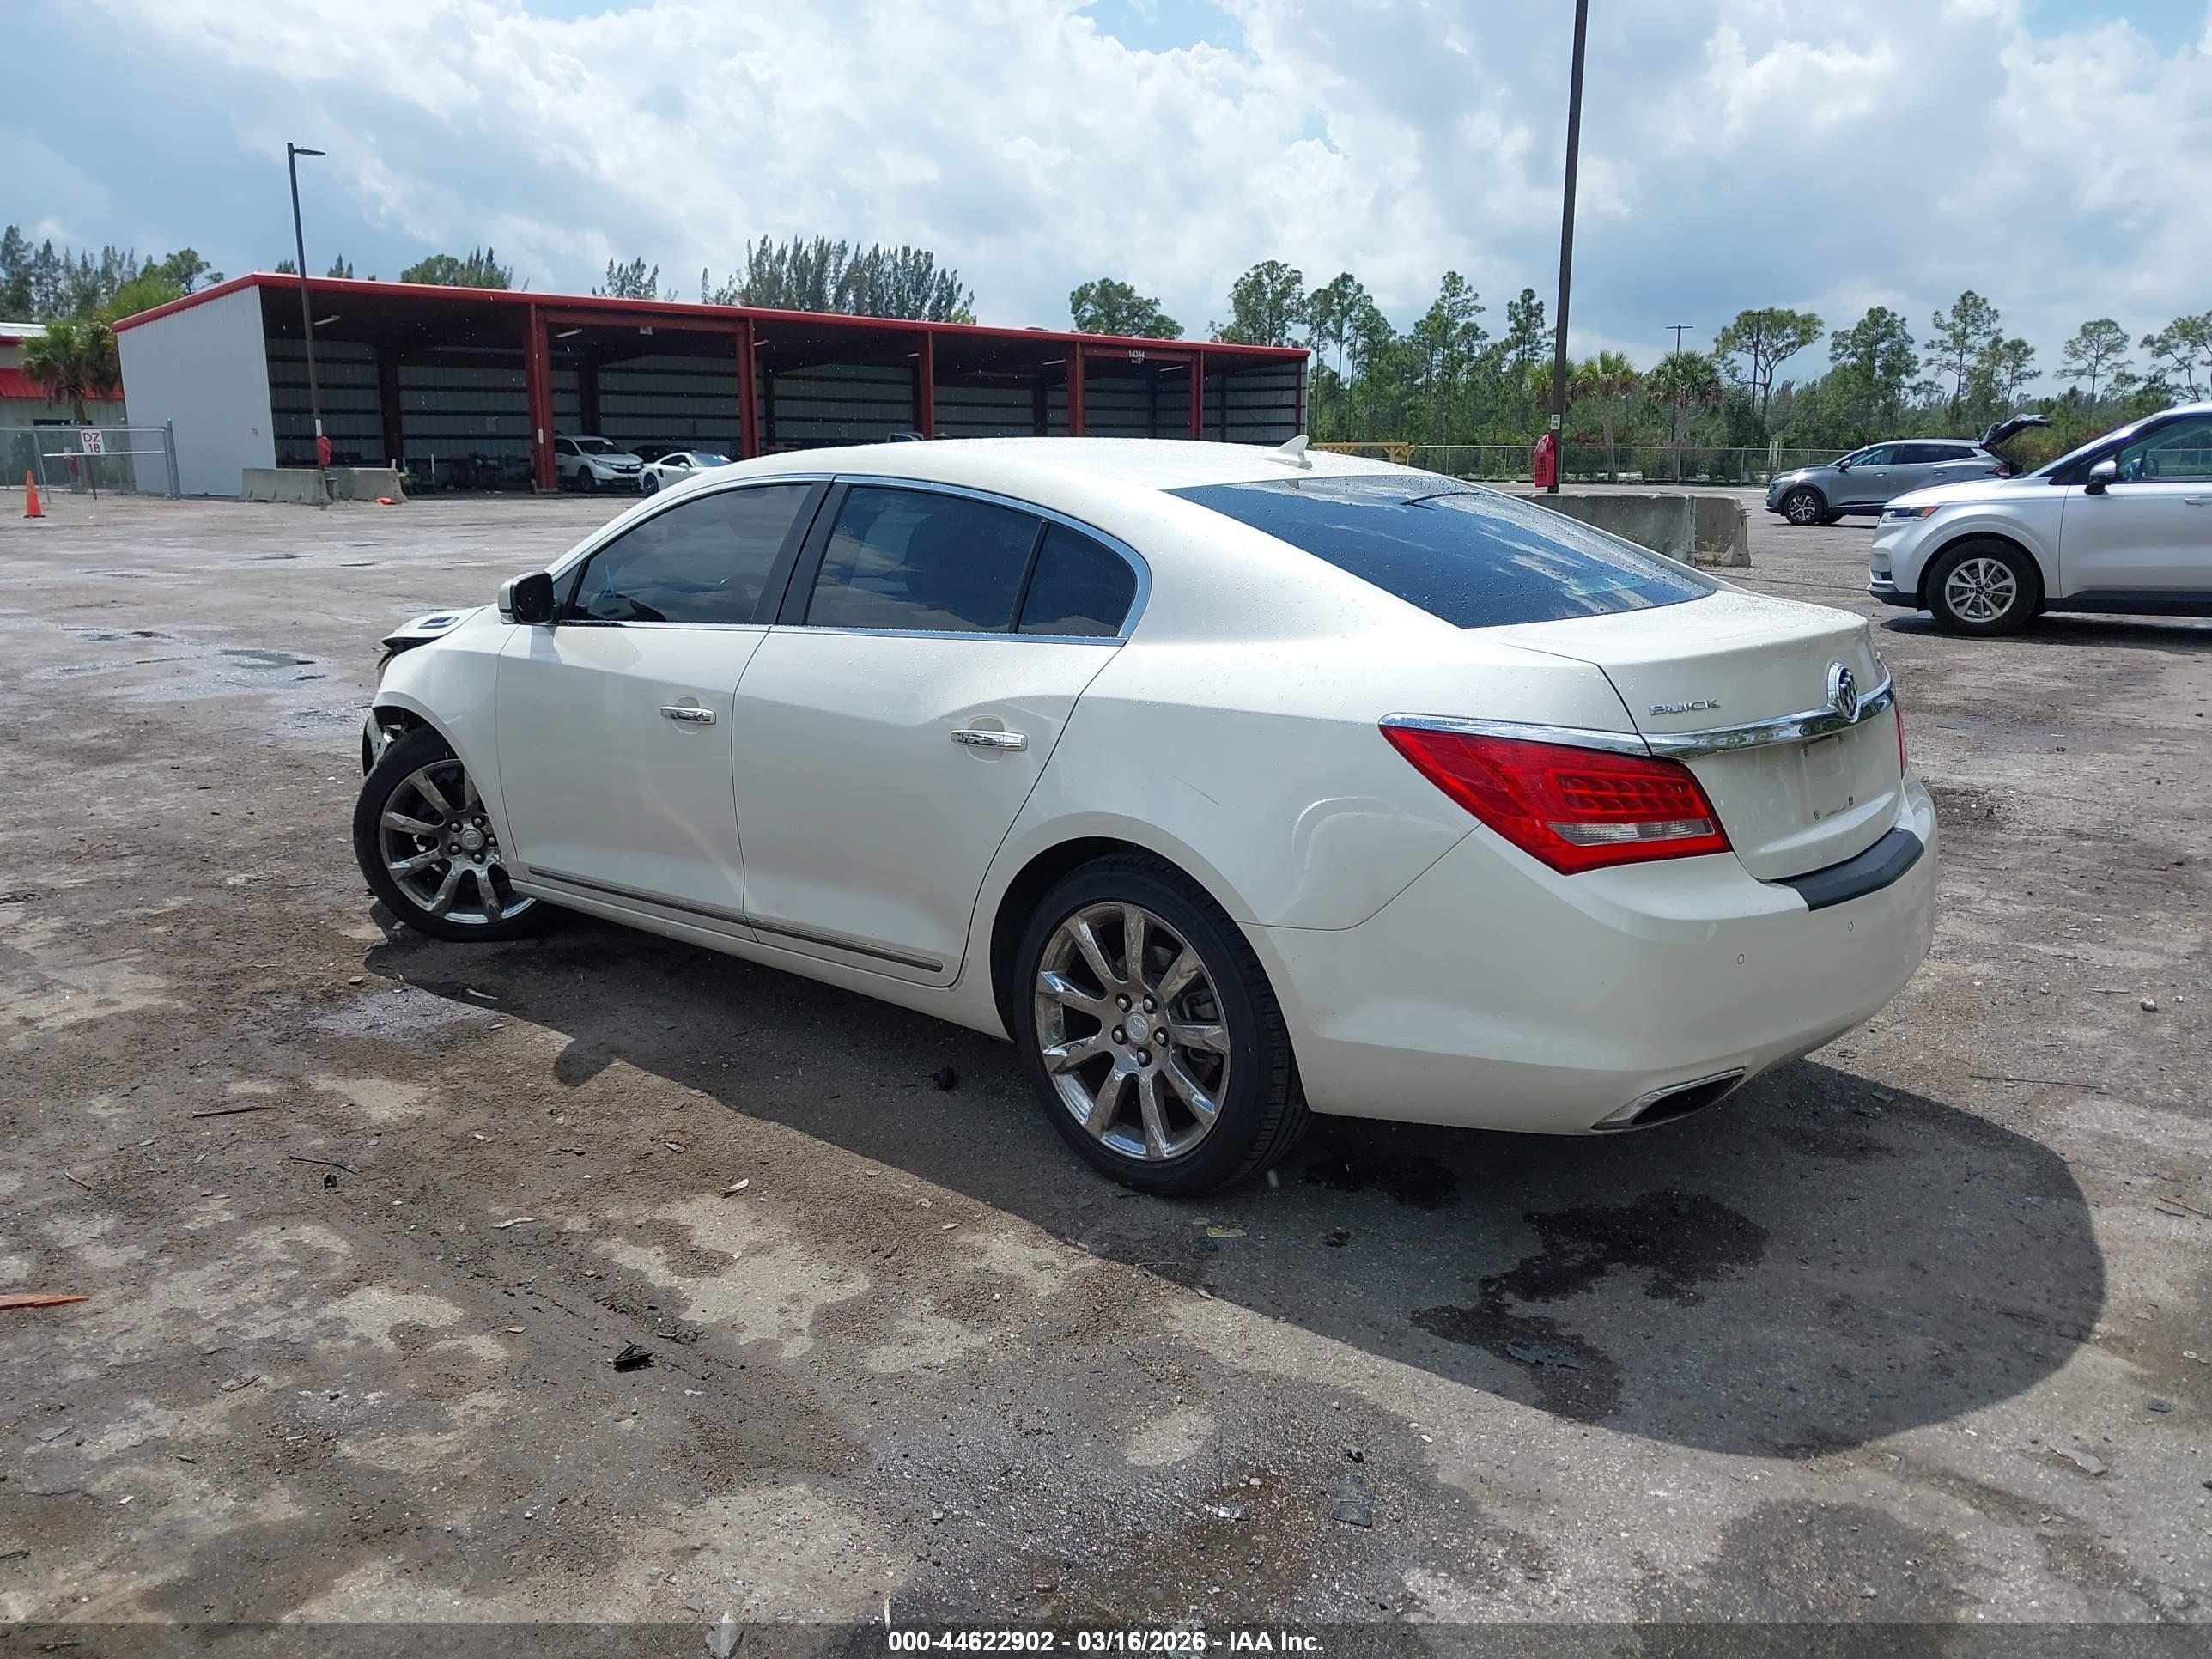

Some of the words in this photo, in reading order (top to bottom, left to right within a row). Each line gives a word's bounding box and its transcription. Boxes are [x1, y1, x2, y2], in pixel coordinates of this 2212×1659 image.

[82, 432, 100, 442] DZ
[88, 443, 100, 453] 18
[1649, 698, 1721, 715] BUICK
